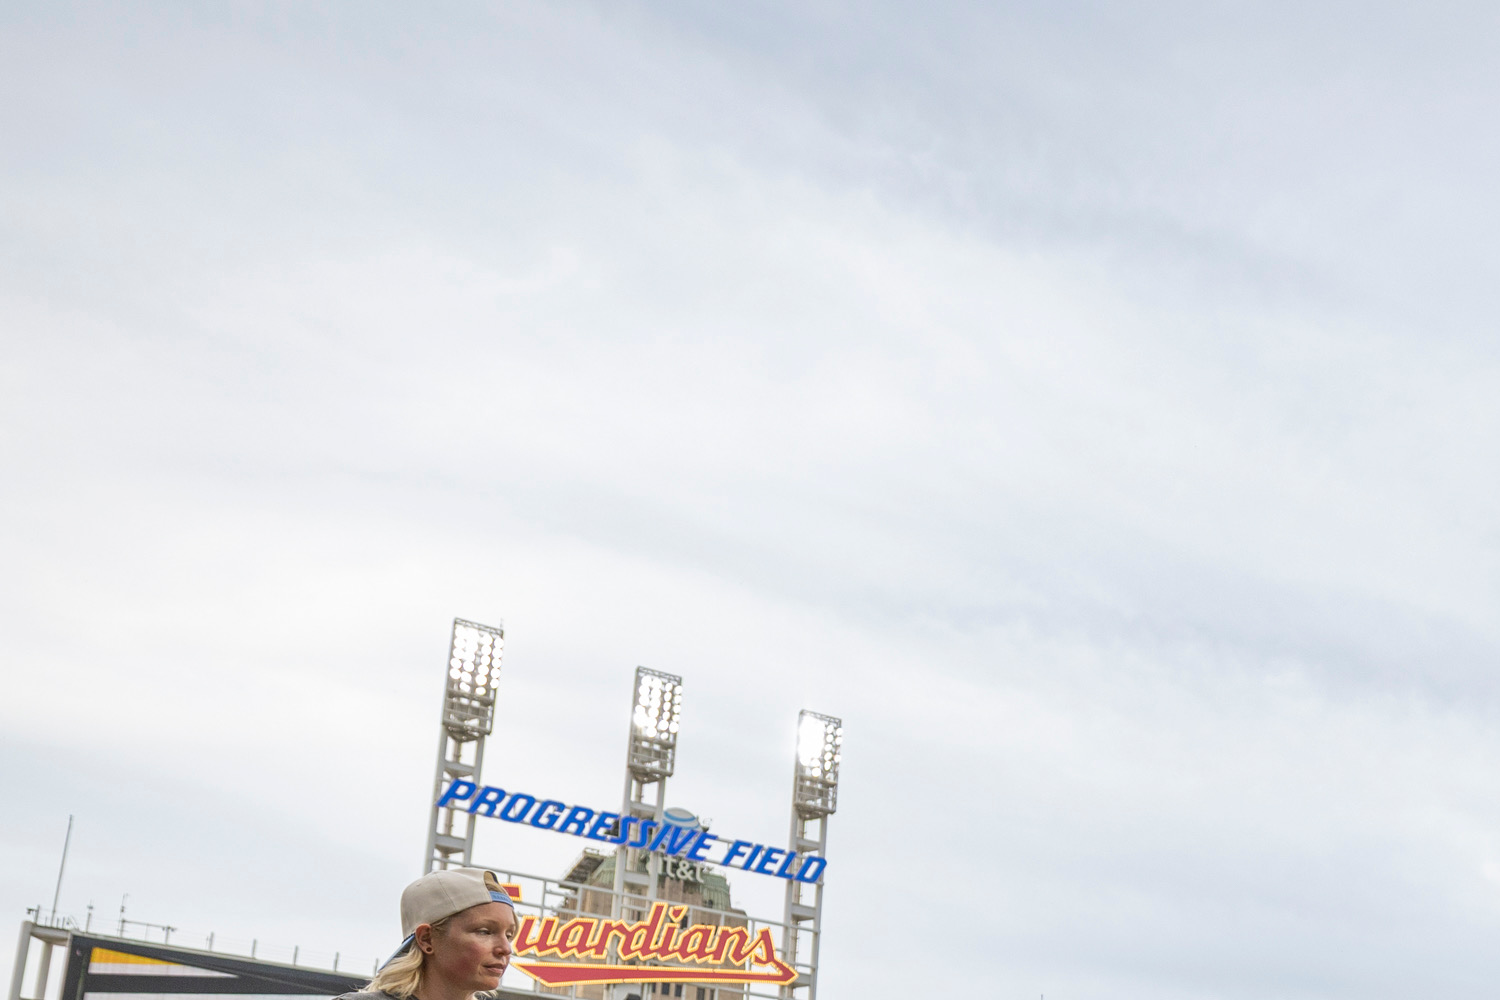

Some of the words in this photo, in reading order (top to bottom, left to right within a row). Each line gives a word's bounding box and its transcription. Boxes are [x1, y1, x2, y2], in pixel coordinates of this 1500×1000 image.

[436, 779, 718, 861] PROGRESSIVE
[721, 840, 827, 883] FIELD
[504, 884, 778, 968] uardians
